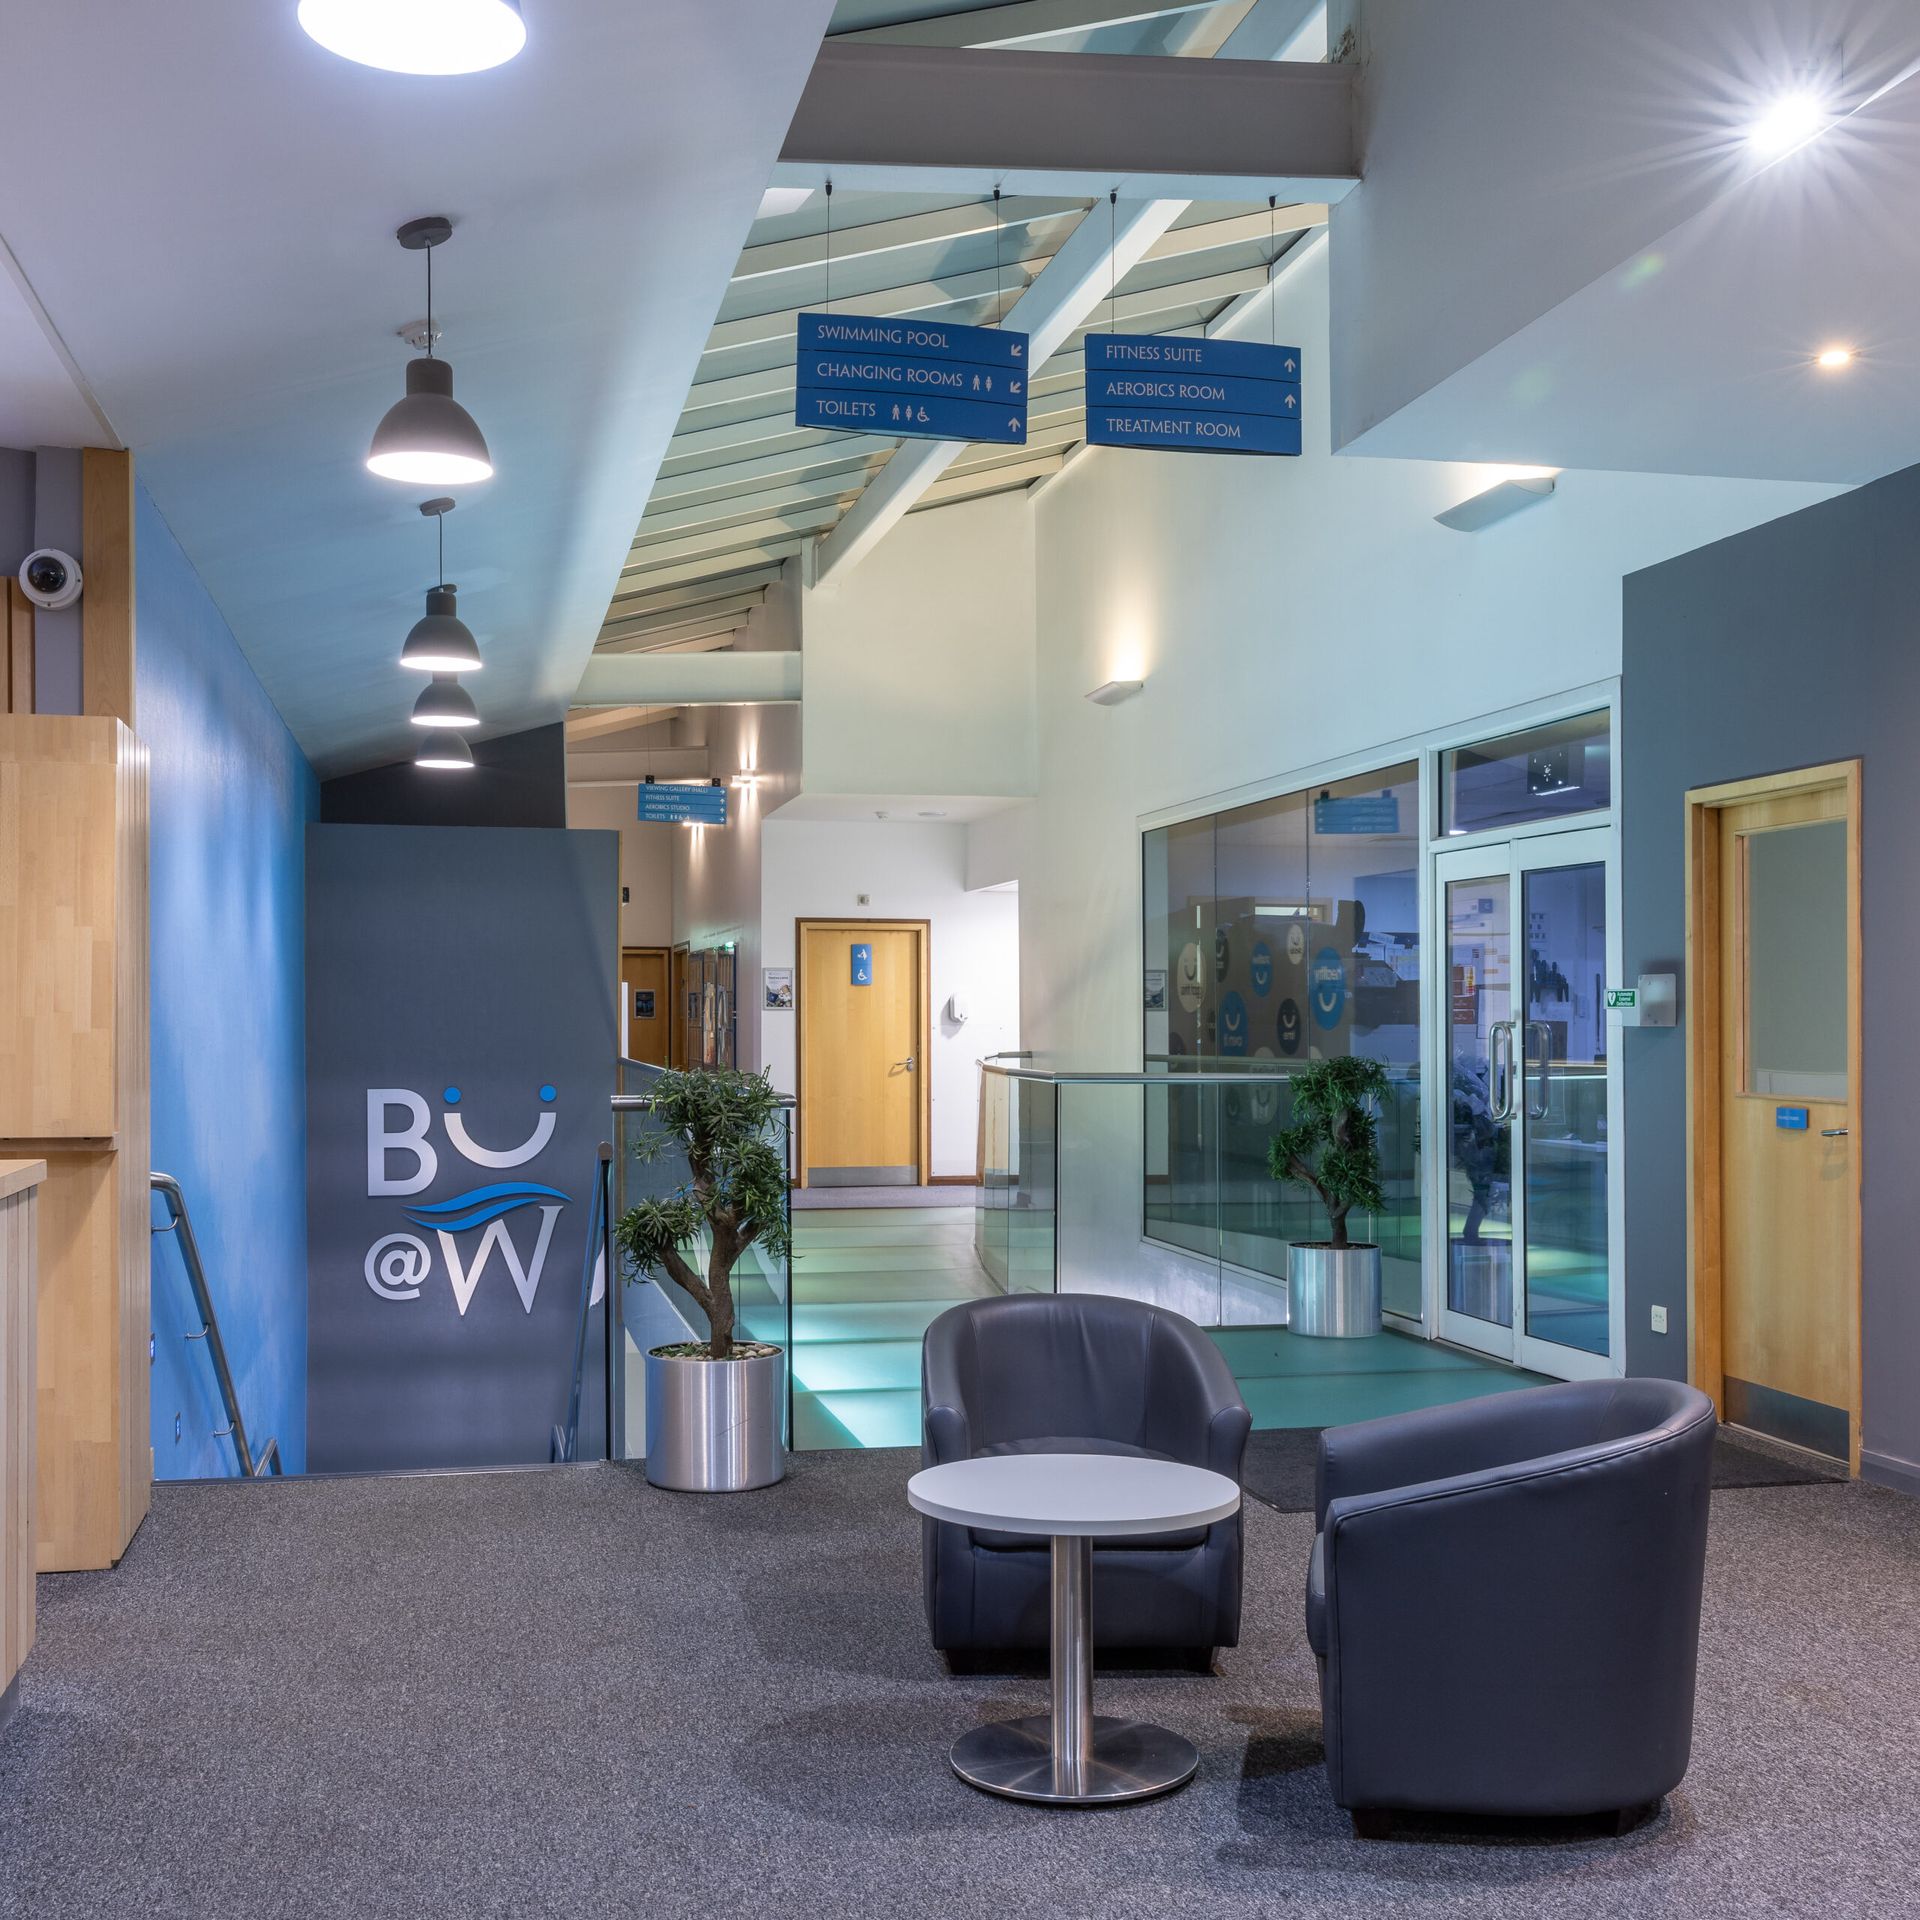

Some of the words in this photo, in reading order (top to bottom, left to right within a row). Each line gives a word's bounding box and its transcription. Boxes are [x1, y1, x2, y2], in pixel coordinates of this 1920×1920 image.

[817, 325, 902, 344] SWIMMING
[907, 332, 949, 348] POOL
[1106, 345, 1160, 360] FITNESS
[1164, 348, 1202, 362] SUITE
[816, 362, 902, 381] CHANGING
[907, 369, 963, 387] ROOMS
[1106, 382, 1174, 397] AEROBICS
[1179, 385, 1225, 400] ROOM
[816, 400, 876, 417] TOILETS
[1106, 418, 1192, 435] TREATMENT
[1196, 422, 1241, 438] ROOM
